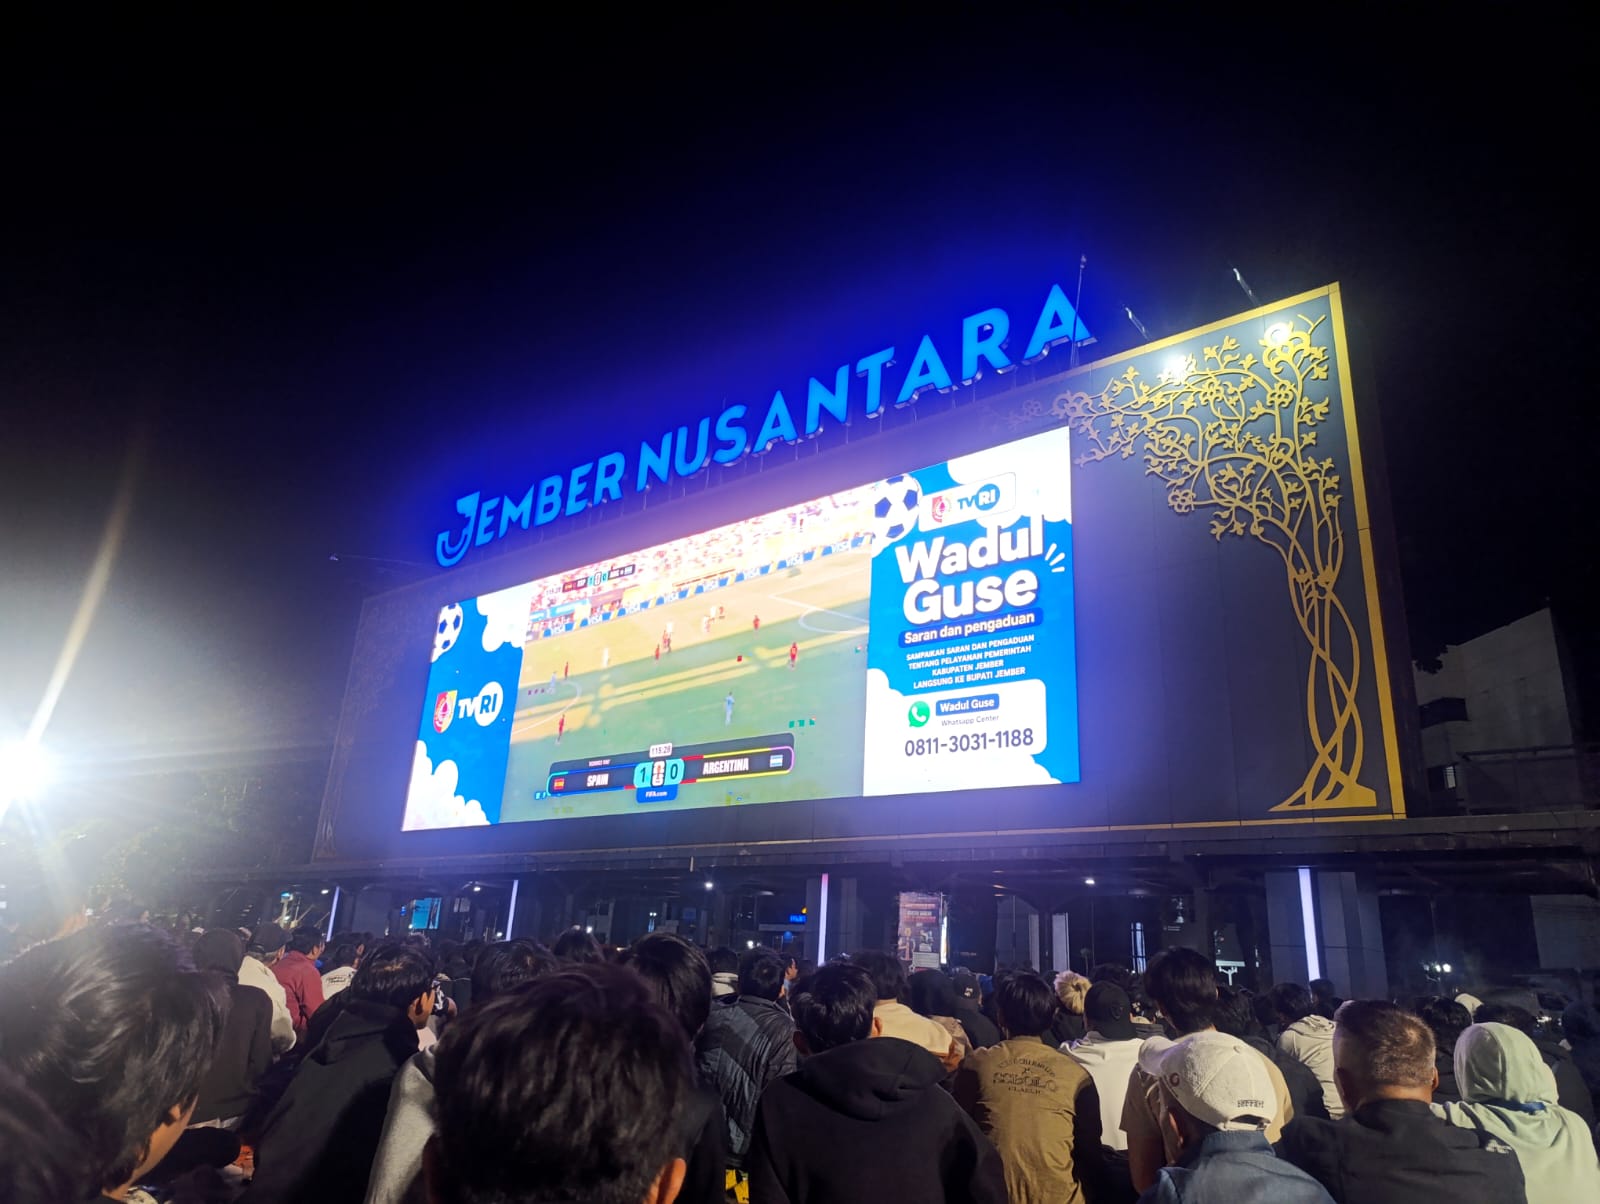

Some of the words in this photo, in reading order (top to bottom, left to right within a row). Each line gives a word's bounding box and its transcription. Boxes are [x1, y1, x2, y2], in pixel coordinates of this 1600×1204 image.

[435, 451, 626, 567] JEMBER
[637, 284, 1094, 492] NUSANTARA
[957, 487, 998, 511] TVRI
[894, 514, 1044, 584] Wadul
[903, 569, 1038, 624] Guse
[904, 629, 938, 644] Saran
[940, 625, 962, 638] dan
[964, 612, 1035, 636] pengaduan
[906, 648, 945, 661] SAMPAIKAN
[946, 644, 970, 655] SARAN
[971, 642, 987, 651] DAN
[988, 634, 1035, 648] PENGADUAN
[908, 659, 940, 670] TENTANG
[941, 654, 983, 665] PELAYANAN
[984, 645, 1031, 659] PEMERINTAH
[913, 677, 953, 689] LANGSUNG
[954, 674, 965, 683] KE
[966, 671, 993, 682] BUPATI
[995, 667, 1026, 678] JEMBER
[932, 664, 973, 676] KABUPATEN
[975, 659, 1004, 670] JEMBER
[458, 691, 500, 719] TVRI
[940, 701, 969, 713] Wadul
[971, 698, 995, 709] Guse
[941, 716, 975, 726] Whatsapp
[976, 714, 1000, 723] Center
[904, 728, 1034, 757] 0811-3031-1188
[586, 773, 609, 787] SPAIN
[640, 767, 646, 783] 1
[670, 763, 678, 780] 0
[703, 758, 749, 775] ARGENTINA
